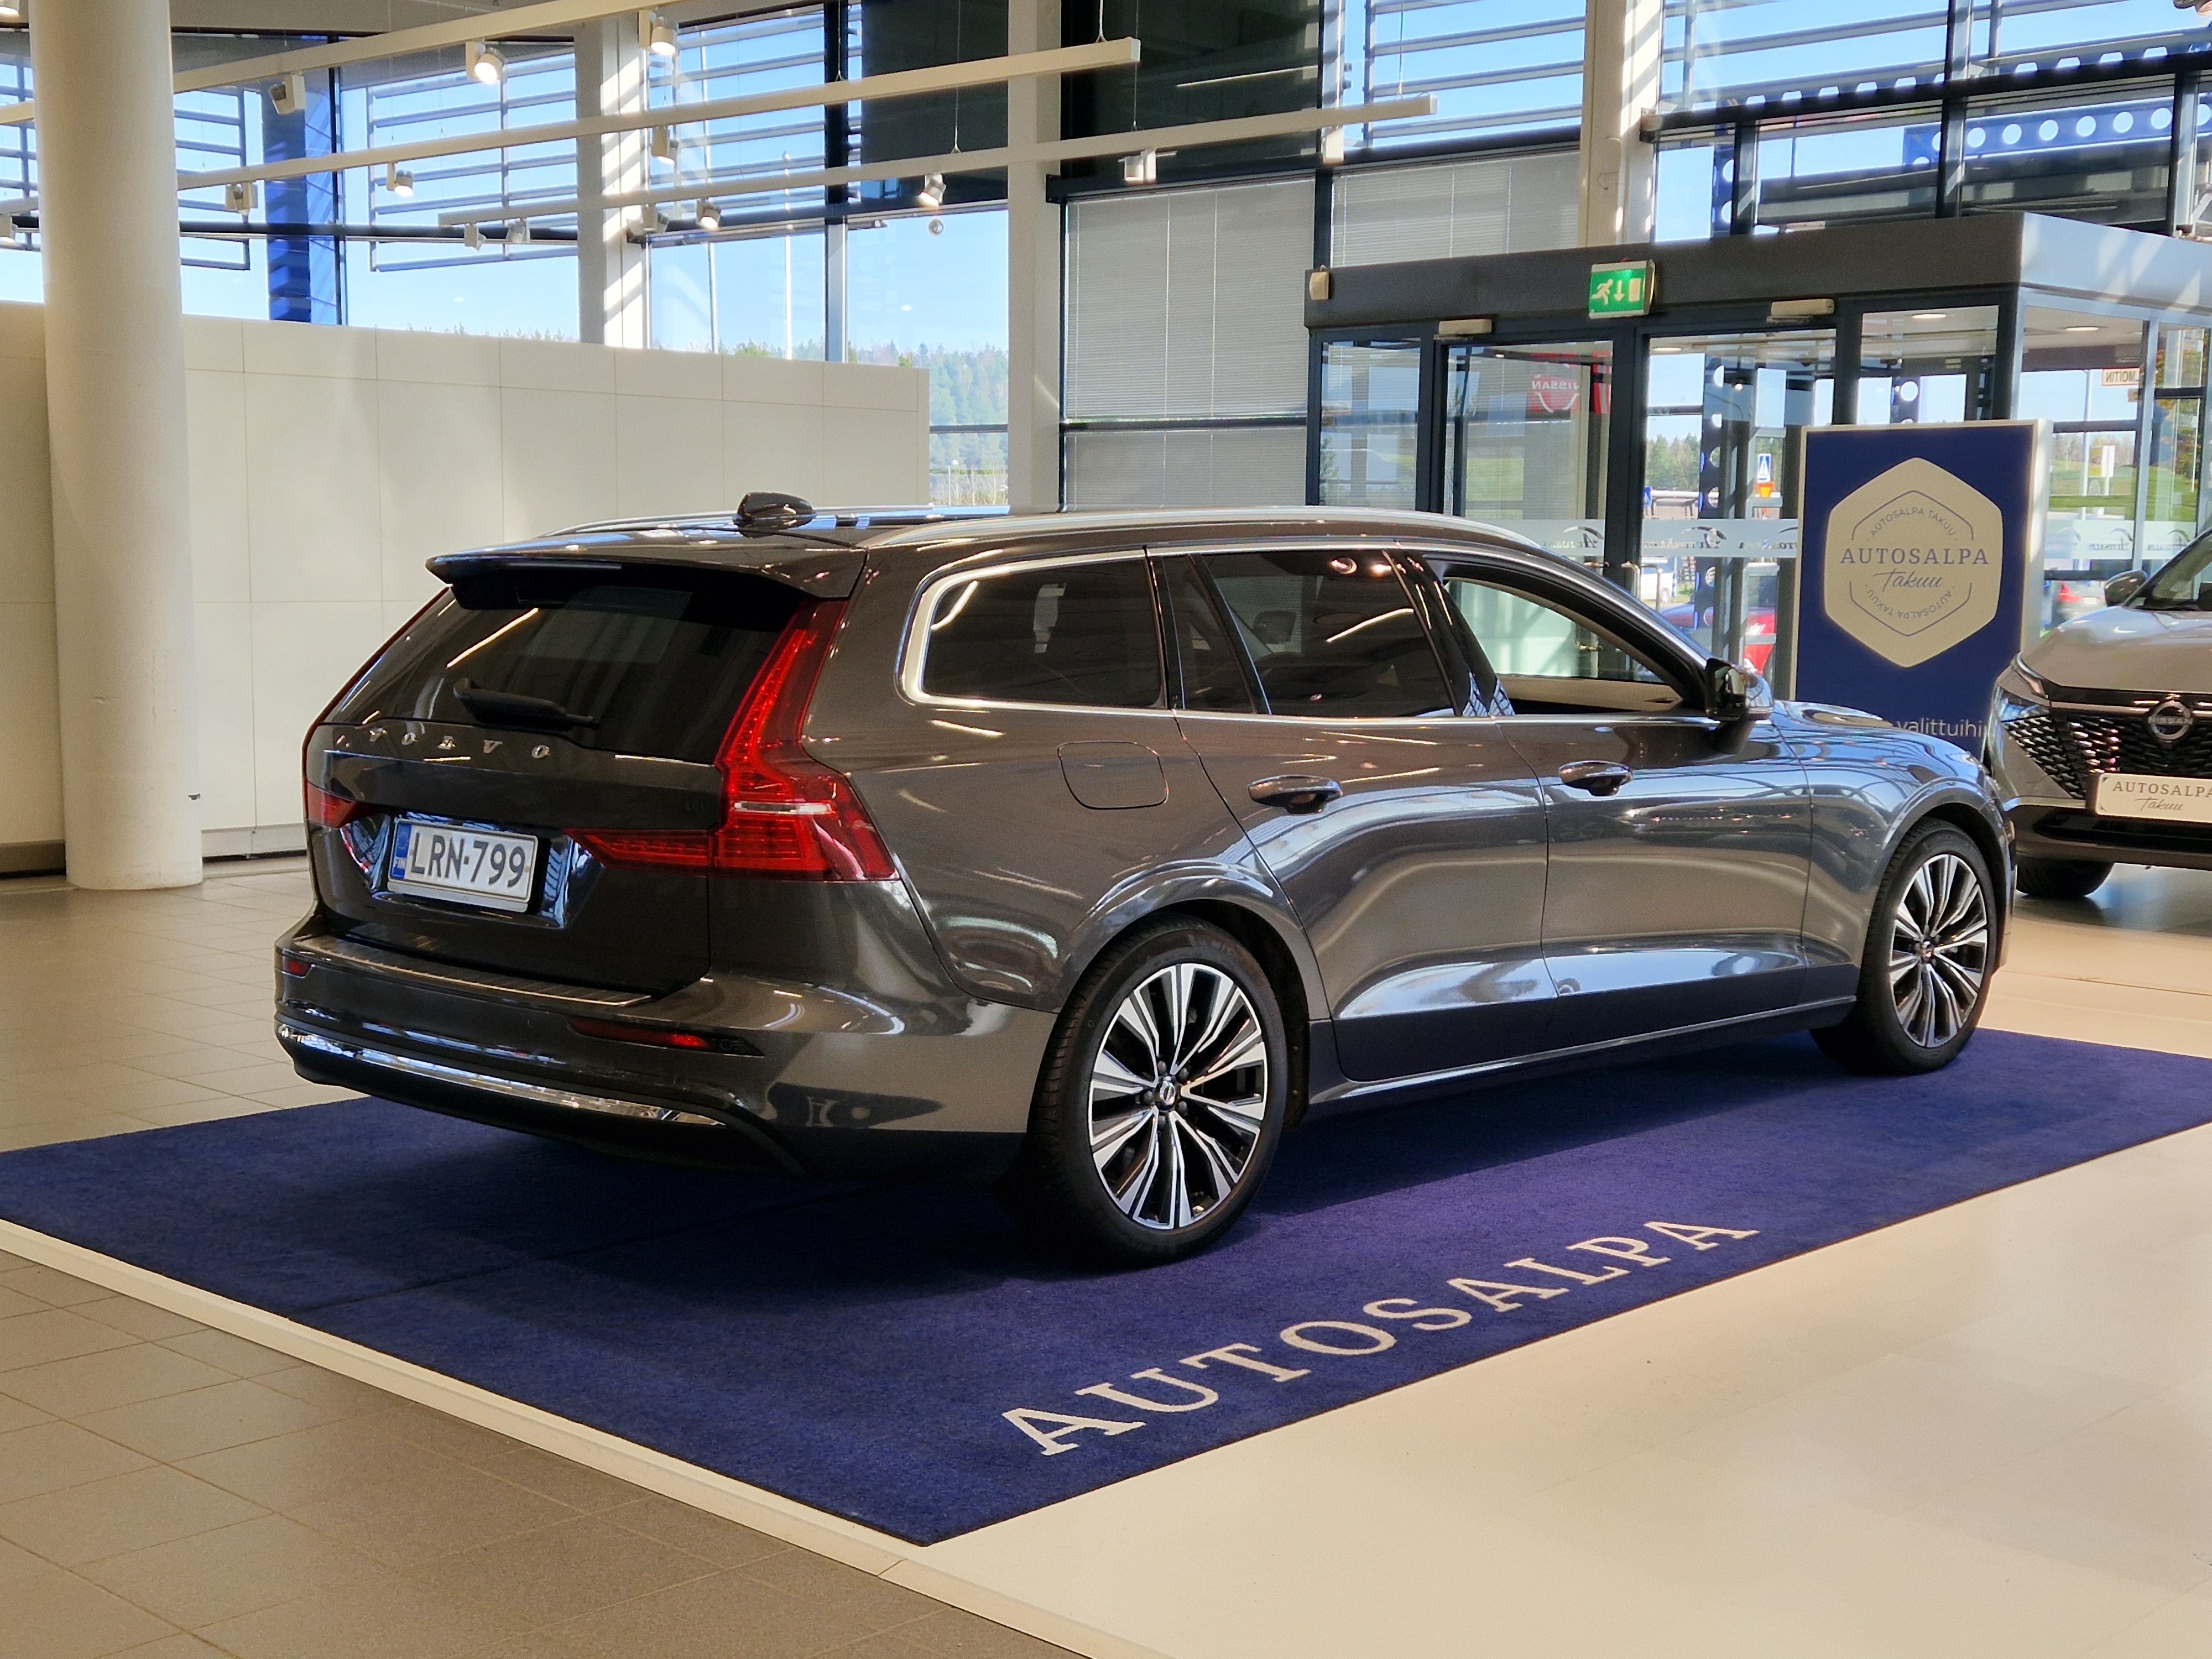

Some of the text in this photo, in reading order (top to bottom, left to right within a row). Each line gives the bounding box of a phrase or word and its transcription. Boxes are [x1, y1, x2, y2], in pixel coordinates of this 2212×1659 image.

[1871, 507, 1956, 537] AUTOSALPA TAKUU
[1840, 548, 1989, 565] AUTOSALPA
[1873, 568, 1943, 592] Takuu
[1867, 589, 1952, 619] AUTOSALPA TAKUU
[369, 727, 550, 759] VOLVO
[2135, 796, 2183, 811] Takuu
[394, 832, 525, 888] FIN LRN-799
[1001, 1220, 1760, 1455] AUTOSALPA
